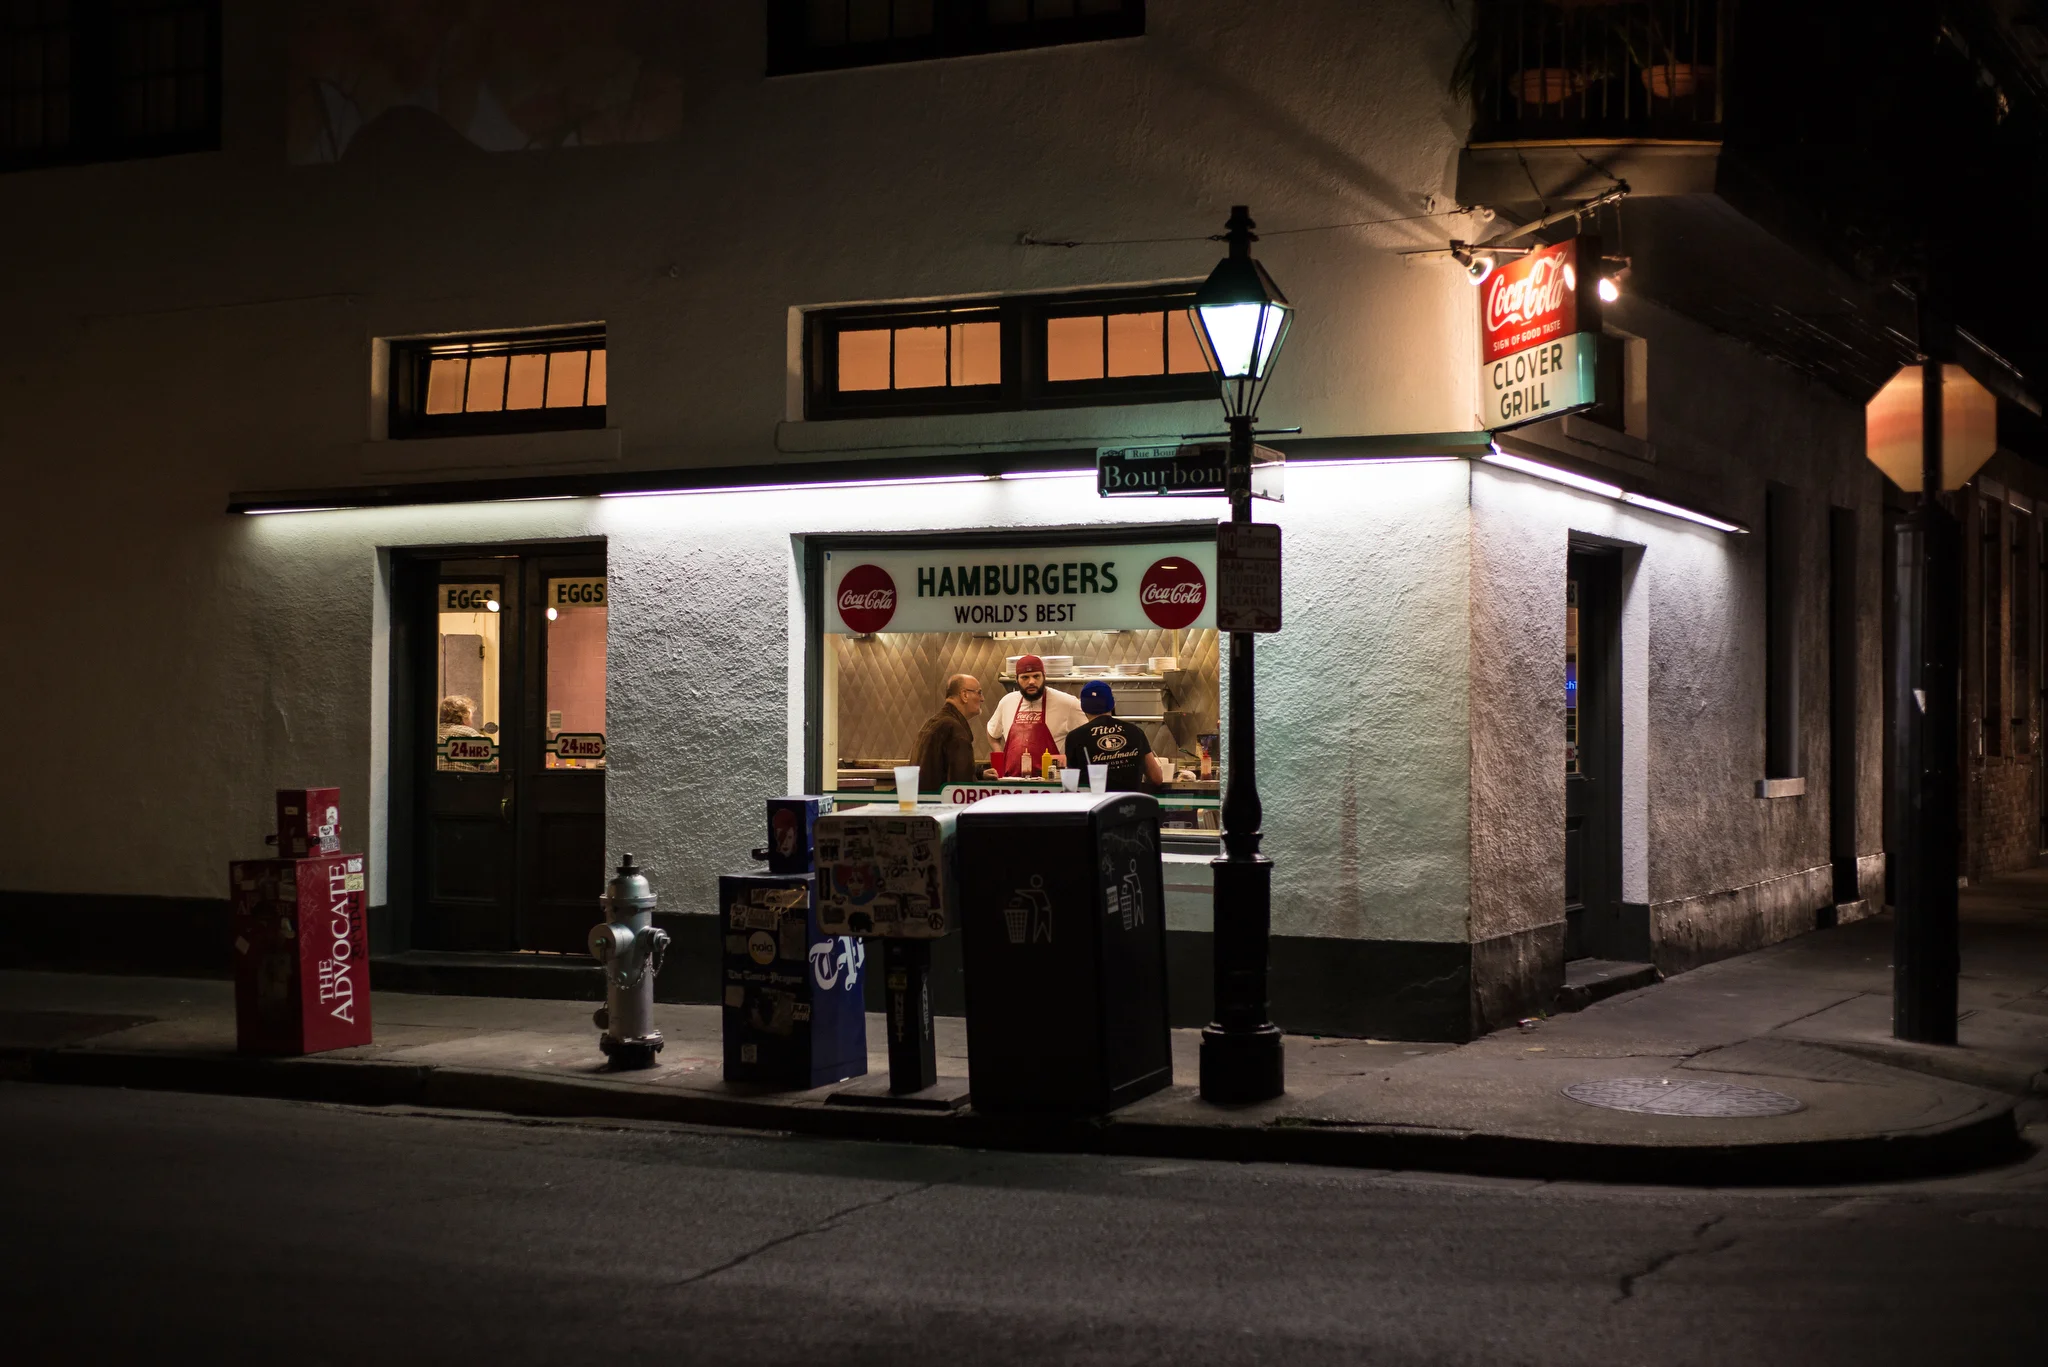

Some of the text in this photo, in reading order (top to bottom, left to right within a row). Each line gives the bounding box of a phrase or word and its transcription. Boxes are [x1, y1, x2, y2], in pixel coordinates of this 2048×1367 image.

[1486, 250, 1568, 332] Coca-Cola
[1493, 319, 1561, 352] SIGN OF GOOD TASTE
[1493, 343, 1563, 390] CLOVER
[1500, 382, 1550, 420] GRILL
[1132, 449, 1149, 458] Rue
[1103, 461, 1222, 488] Bourbon
[1220, 532, 1236, 552] NO
[917, 561, 1119, 597] HAMBURGERS
[447, 589, 493, 610] EGGS
[557, 583, 605, 604] EGGS
[838, 588, 896, 611] Coca-Cola
[1141, 582, 1204, 605] Coca-Cola
[954, 603, 1077, 624] WORLD'S BEST
[1090, 724, 1123, 737] Tito's
[1092, 747, 1139, 763] Handmade
[318, 958, 335, 1005] THE
[328, 862, 355, 1025] ADVOCATE
[752, 940, 773, 952] nola
